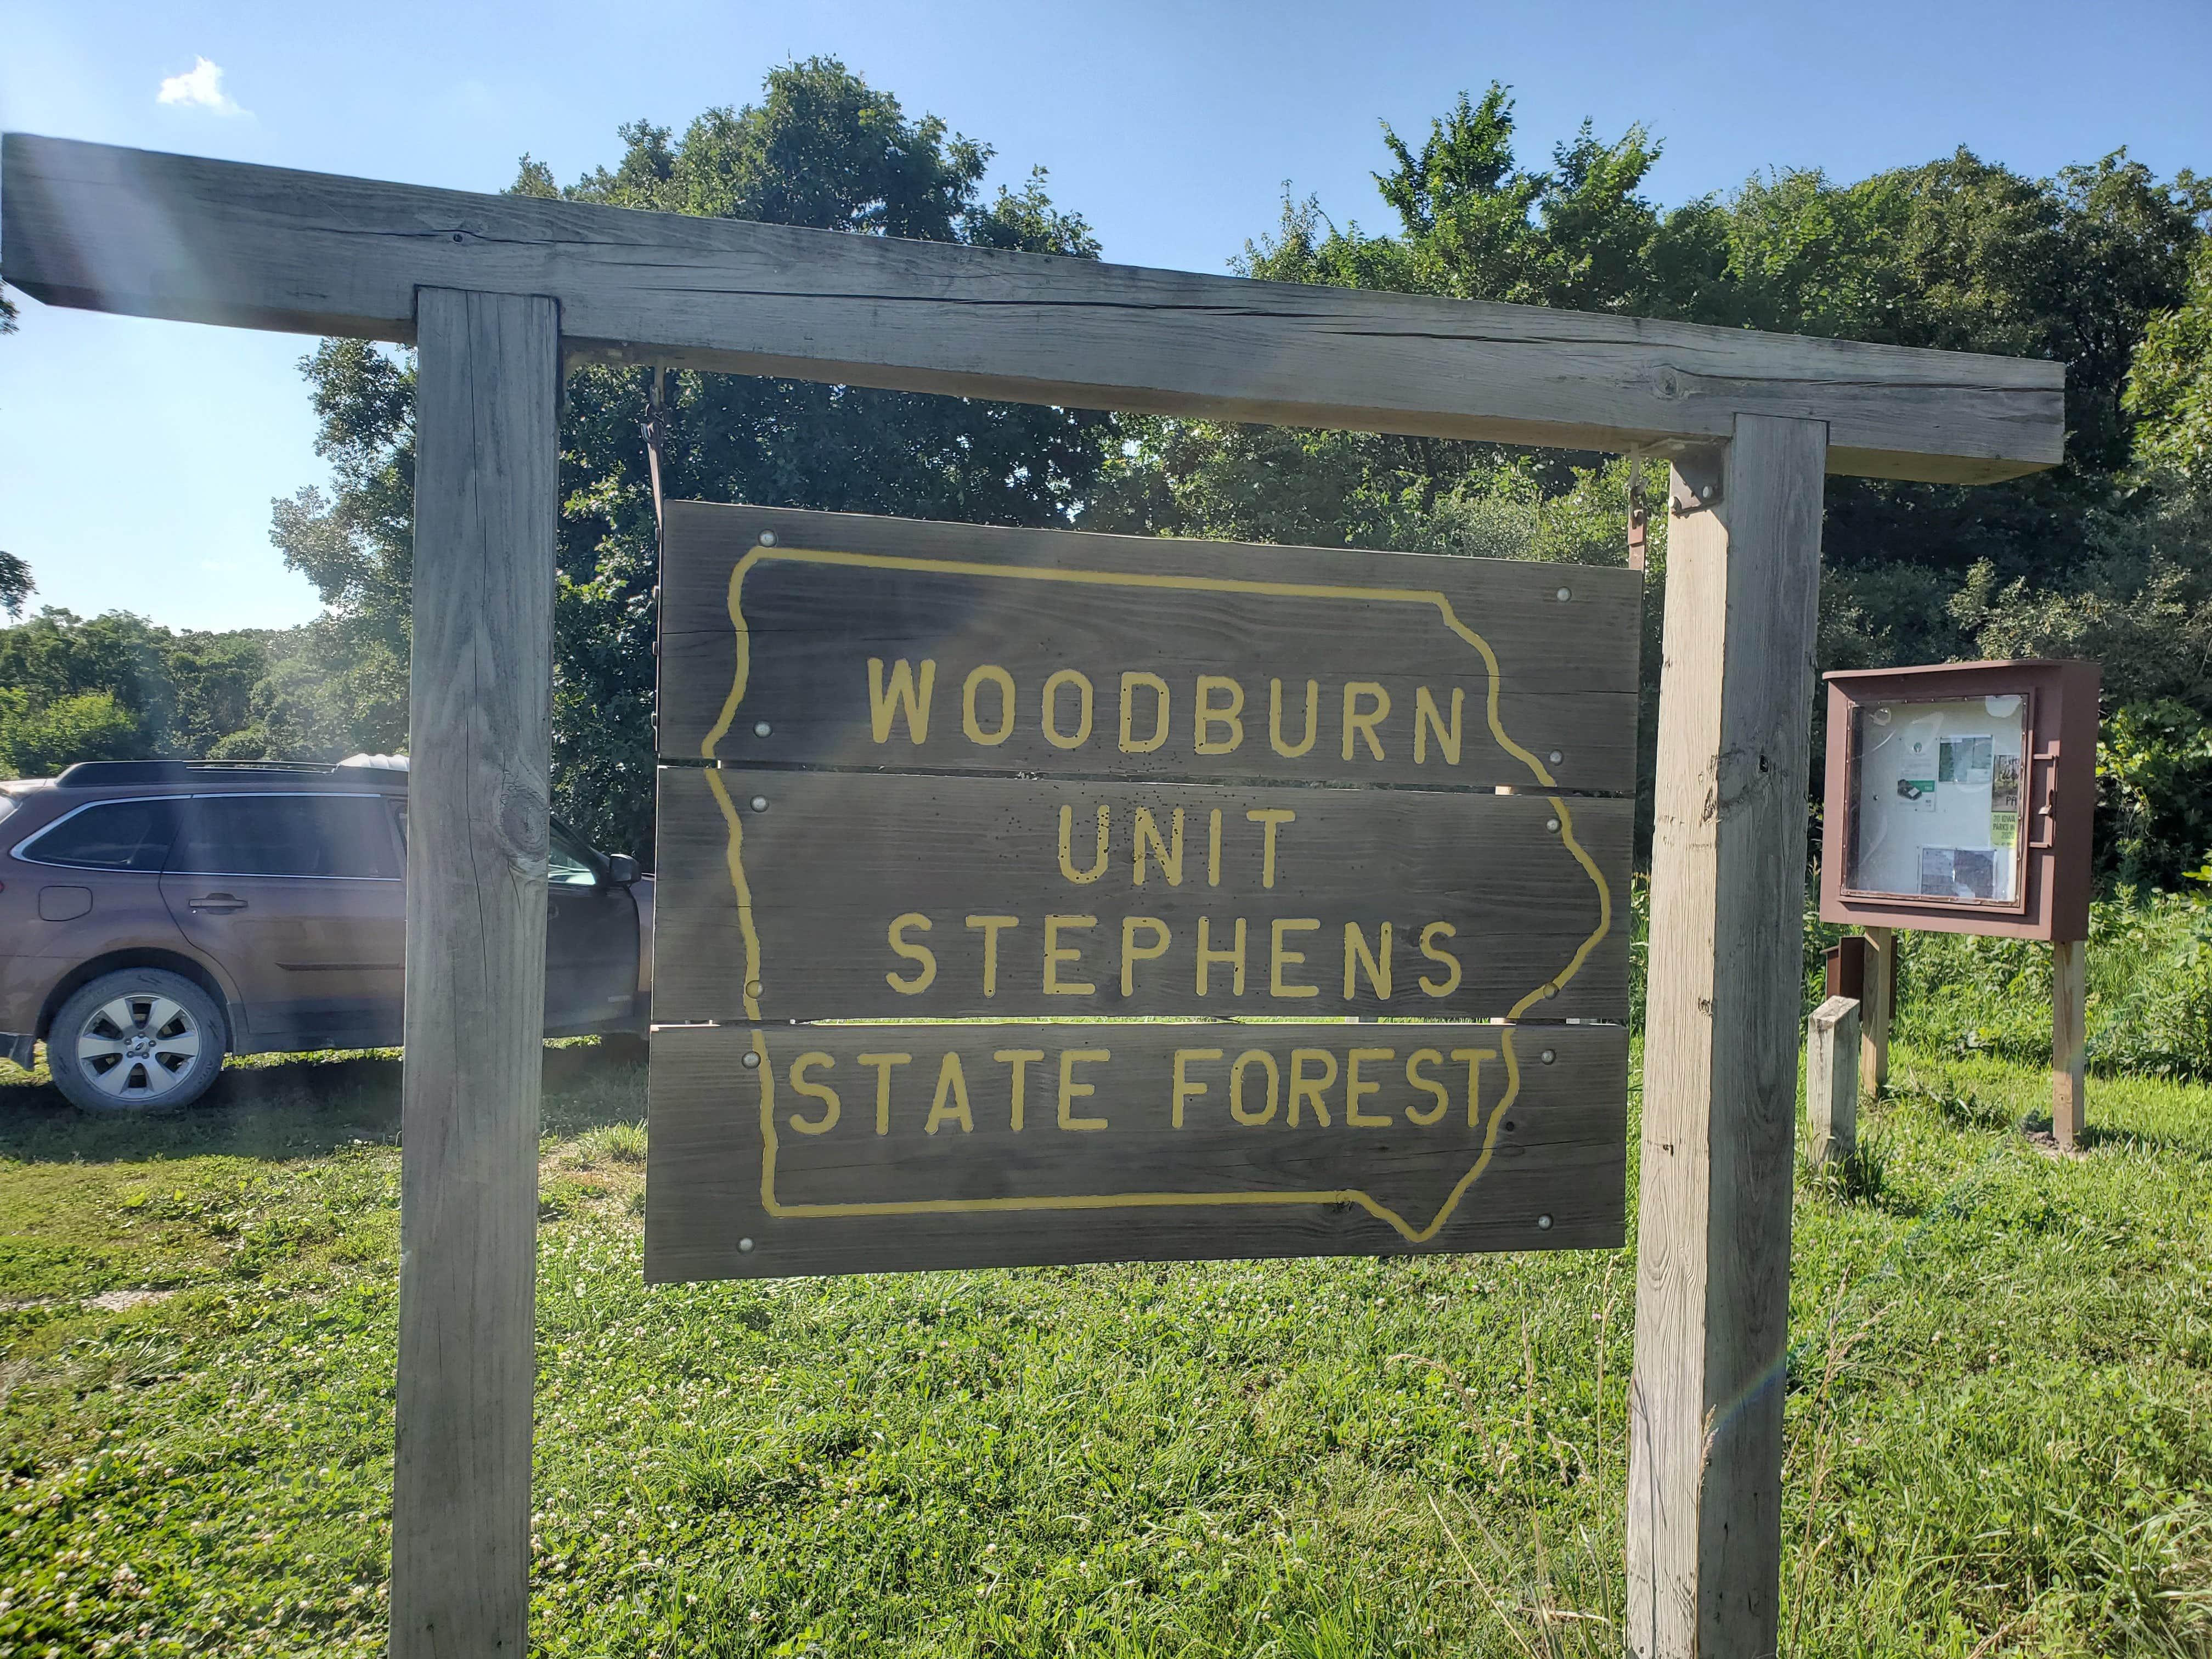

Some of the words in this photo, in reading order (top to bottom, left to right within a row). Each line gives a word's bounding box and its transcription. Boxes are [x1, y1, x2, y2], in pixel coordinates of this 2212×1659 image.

[868, 658, 1464, 765] WOODBURN
[1059, 805, 1296, 888] UNIT
[2001, 831, 2015, 839] 2020
[887, 913, 1462, 999] STEPHENS
[789, 1052, 1110, 1135] STATE
[1172, 1048, 1497, 1128] FOREST
